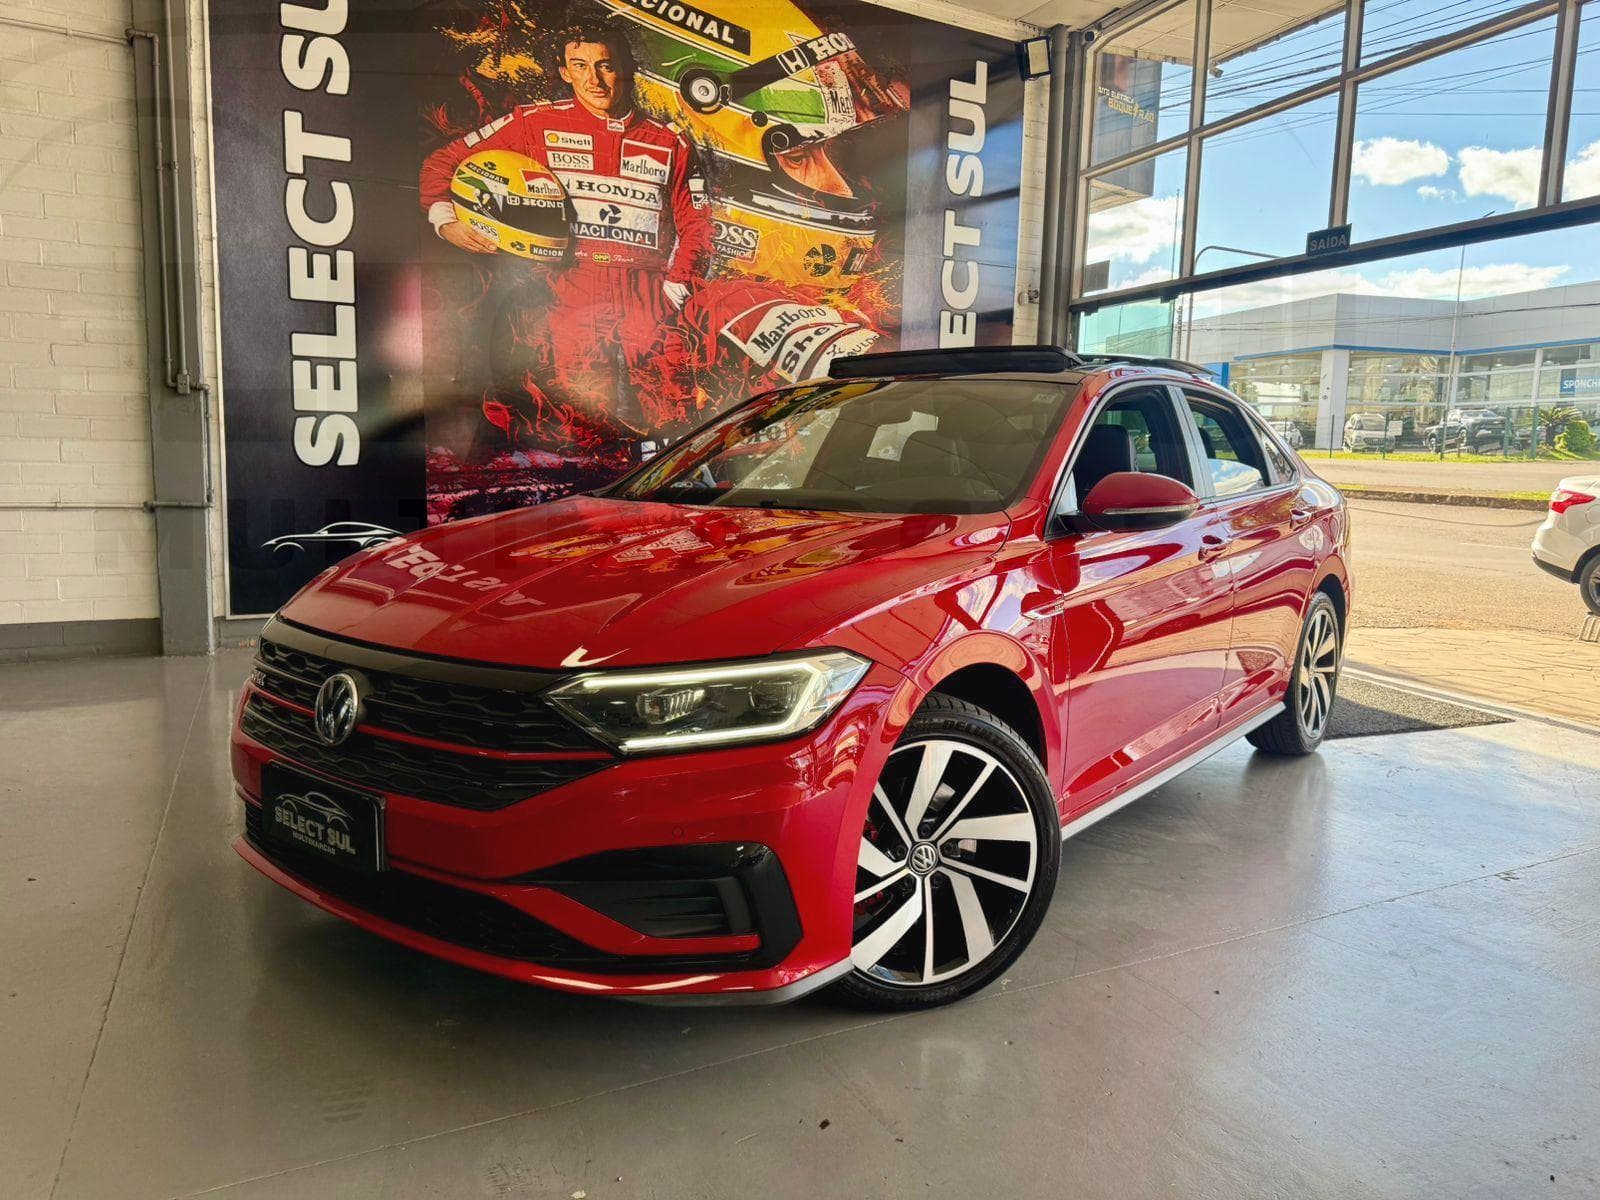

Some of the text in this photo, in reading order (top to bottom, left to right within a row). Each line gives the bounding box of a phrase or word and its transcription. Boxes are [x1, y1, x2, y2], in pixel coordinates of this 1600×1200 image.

[945, 60, 988, 198] SUL
[561, 136, 591, 147] Shell
[551, 152, 590, 166] BOSS
[621, 158, 666, 178] Marlboro
[467, 163, 505, 183] NACIONAL
[575, 179, 660, 205] HONDA
[716, 244, 752, 259] FASHION
[1310, 233, 1348, 251] SAÍDA
[284, 110, 361, 467] SELECT
[750, 306, 827, 354] Marlboro
[274, 804, 356, 855] SELECT SUL
